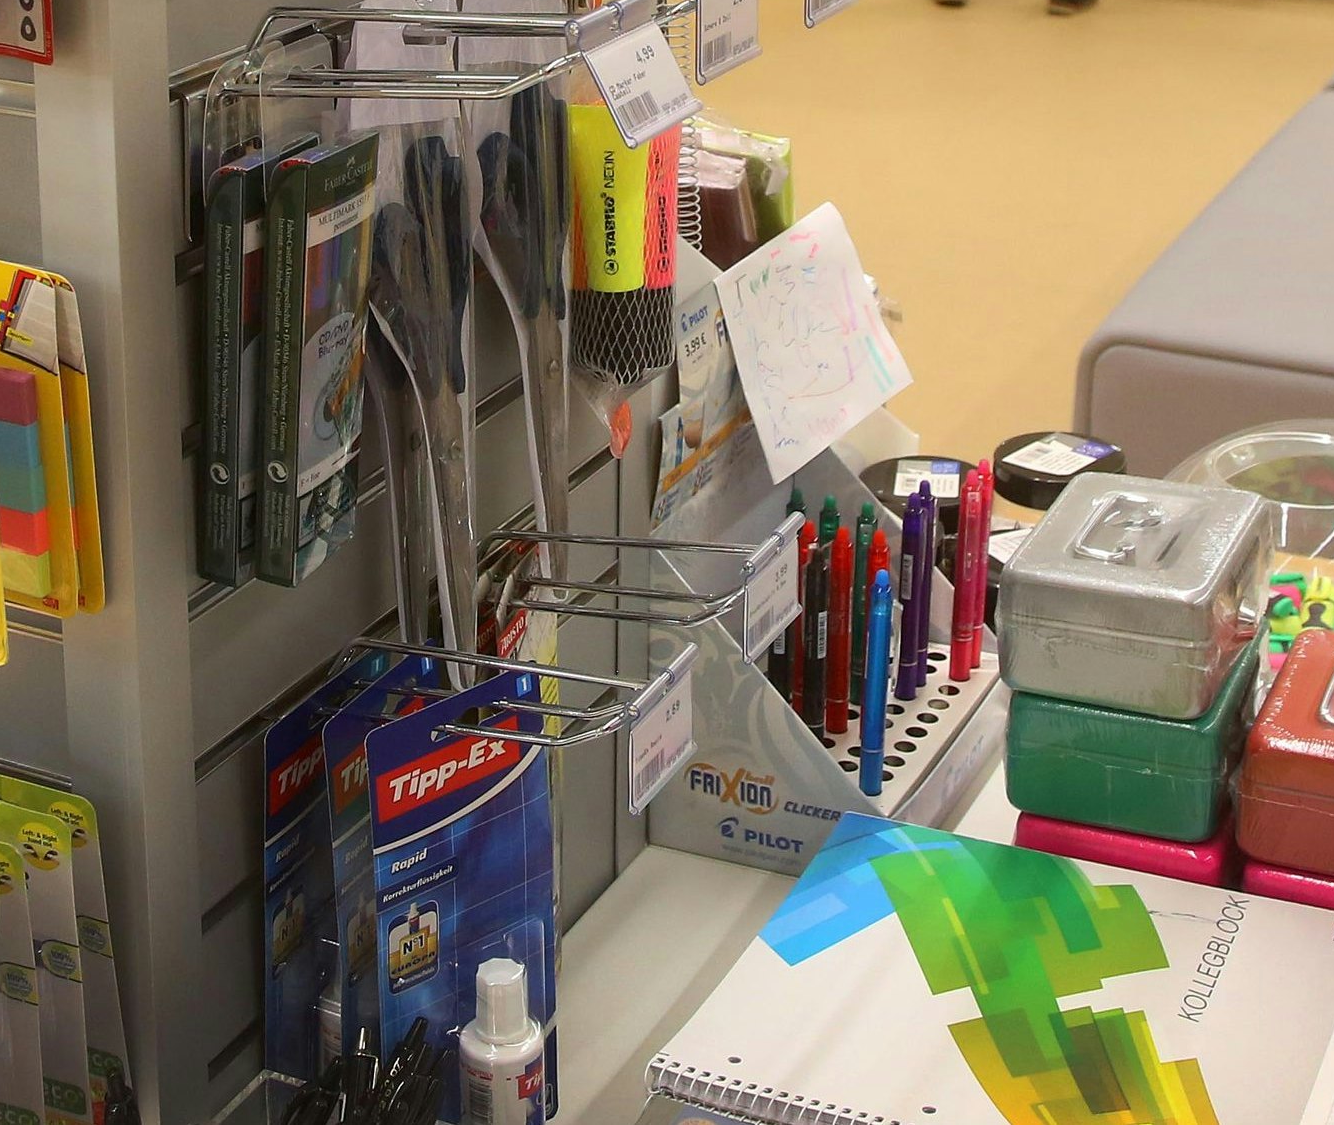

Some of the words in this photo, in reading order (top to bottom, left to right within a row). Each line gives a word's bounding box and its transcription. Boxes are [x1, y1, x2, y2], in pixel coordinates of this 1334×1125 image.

[635, 44, 656, 65] 4,99
[603, 150, 615, 189] NEON
[603, 193, 617, 257] STABILO
[688, 305, 709, 328] PILOT
[388, 737, 507, 803] Tipp-Ex
[784, 800, 841, 821] CLICKER
[743, 829, 805, 852] PILOT
[391, 848, 428, 874] Rapid
[382, 863, 454, 904] Korrekturflüssigkeit
[1177, 894, 1251, 1024] KOLLEGBLOCK
